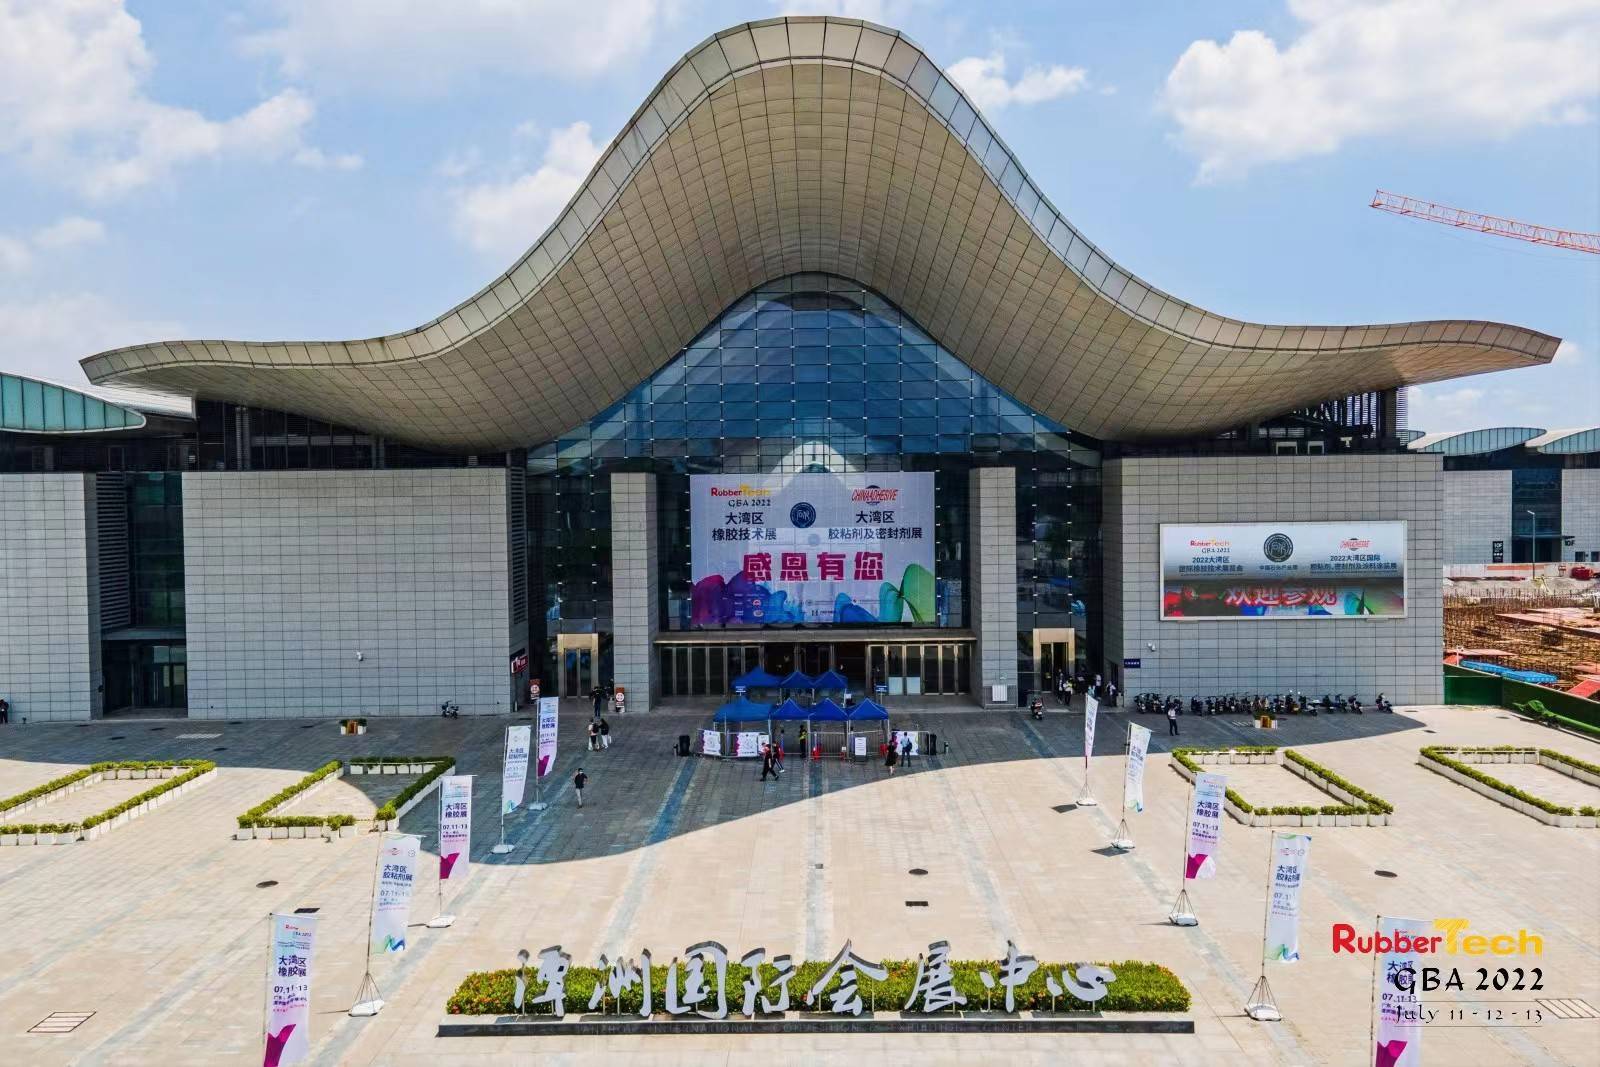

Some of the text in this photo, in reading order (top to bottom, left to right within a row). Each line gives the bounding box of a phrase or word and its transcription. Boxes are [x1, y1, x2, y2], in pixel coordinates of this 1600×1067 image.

[711, 484, 770, 497] RubberTech
[728, 500, 749, 508] GBA
[725, 512, 764, 525] 大湾区
[856, 511, 895, 523] 大湾区
[712, 528, 776, 541] 橡胶技术展
[828, 528, 923, 540] 胶粘剂及密封剂展
[743, 551, 883, 581] 感恩有您
[384, 864, 407, 873] 大湾区
[279, 955, 307, 967] 大湾区
[278, 966, 307, 977] 橡胶展
